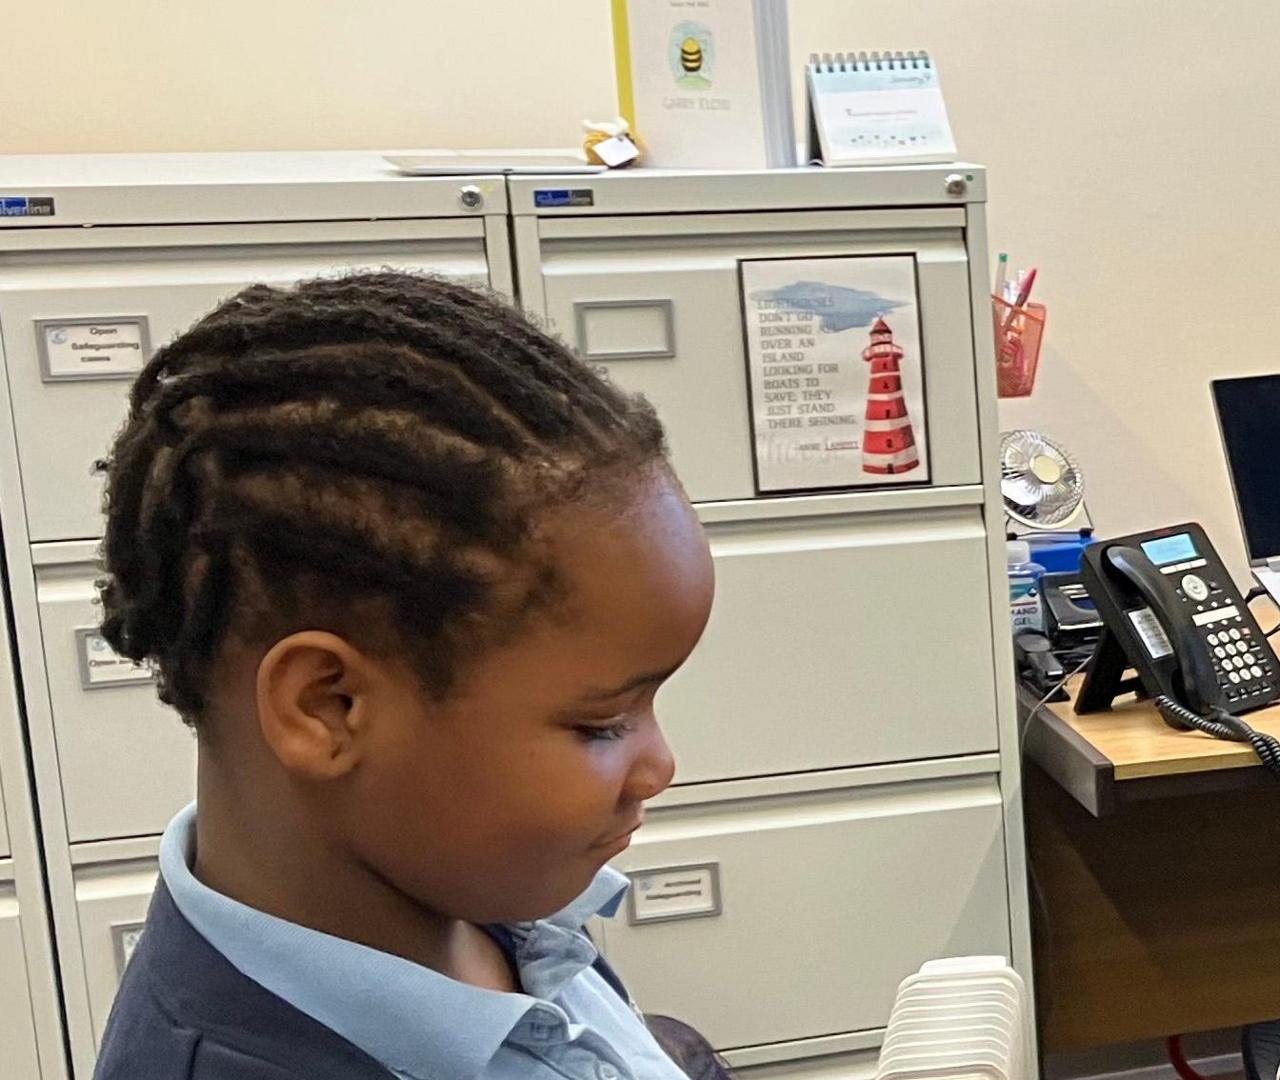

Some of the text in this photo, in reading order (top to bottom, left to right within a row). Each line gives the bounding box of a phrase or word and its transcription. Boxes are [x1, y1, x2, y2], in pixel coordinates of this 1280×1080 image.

[761, 338, 816, 349] OVER AN
[762, 352, 805, 363] ISLAND
[764, 363, 839, 377] LOOKING FOR
[764, 377, 820, 390] BOATS TO
[802, 389, 832, 401] THEY
[797, 402, 836, 415] STAND
[768, 417, 803, 429] THERE
